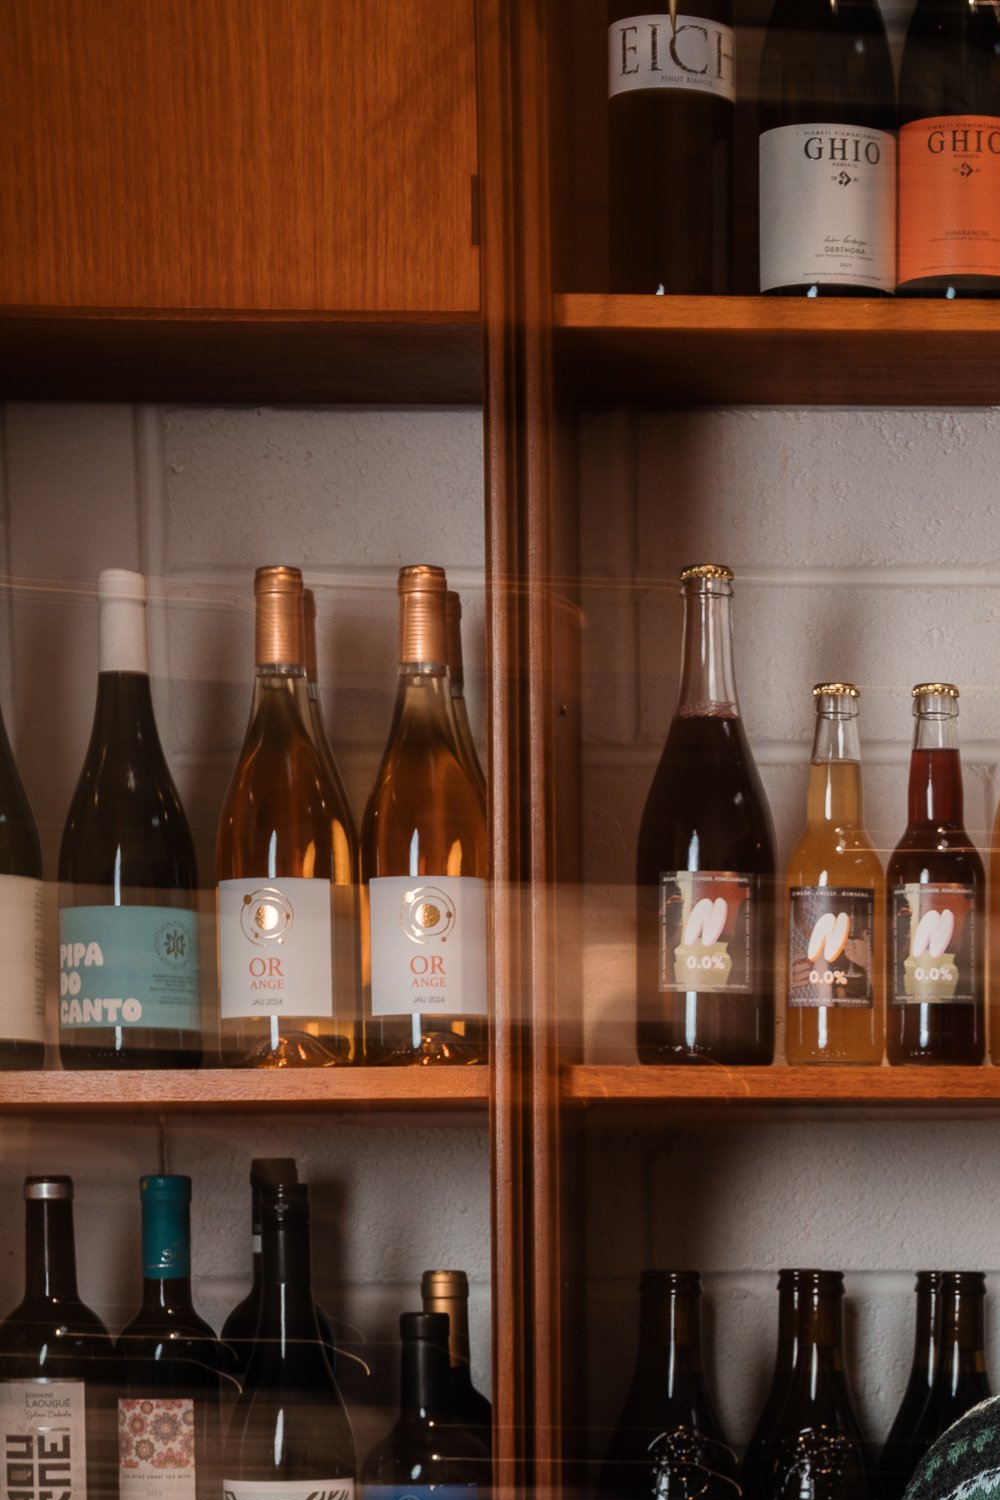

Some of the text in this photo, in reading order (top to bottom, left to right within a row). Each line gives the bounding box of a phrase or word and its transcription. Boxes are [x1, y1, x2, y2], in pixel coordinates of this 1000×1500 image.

[661, 75, 712, 86] PINOT BIANCO
[804, 137, 880, 165] GHIO
[824, 246, 866, 255] DERTHONA
[60, 941, 104, 968] PIPA
[249, 957, 285, 977] OR
[410, 955, 446, 975] OR
[686, 955, 726, 970] 0.0%
[809, 970, 848, 985] 0.0%
[915, 967, 953, 981] 0.0%
[250, 980, 285, 990] ANGE
[411, 977, 447, 988] ANGE
[61, 998, 143, 1024] CANTO
